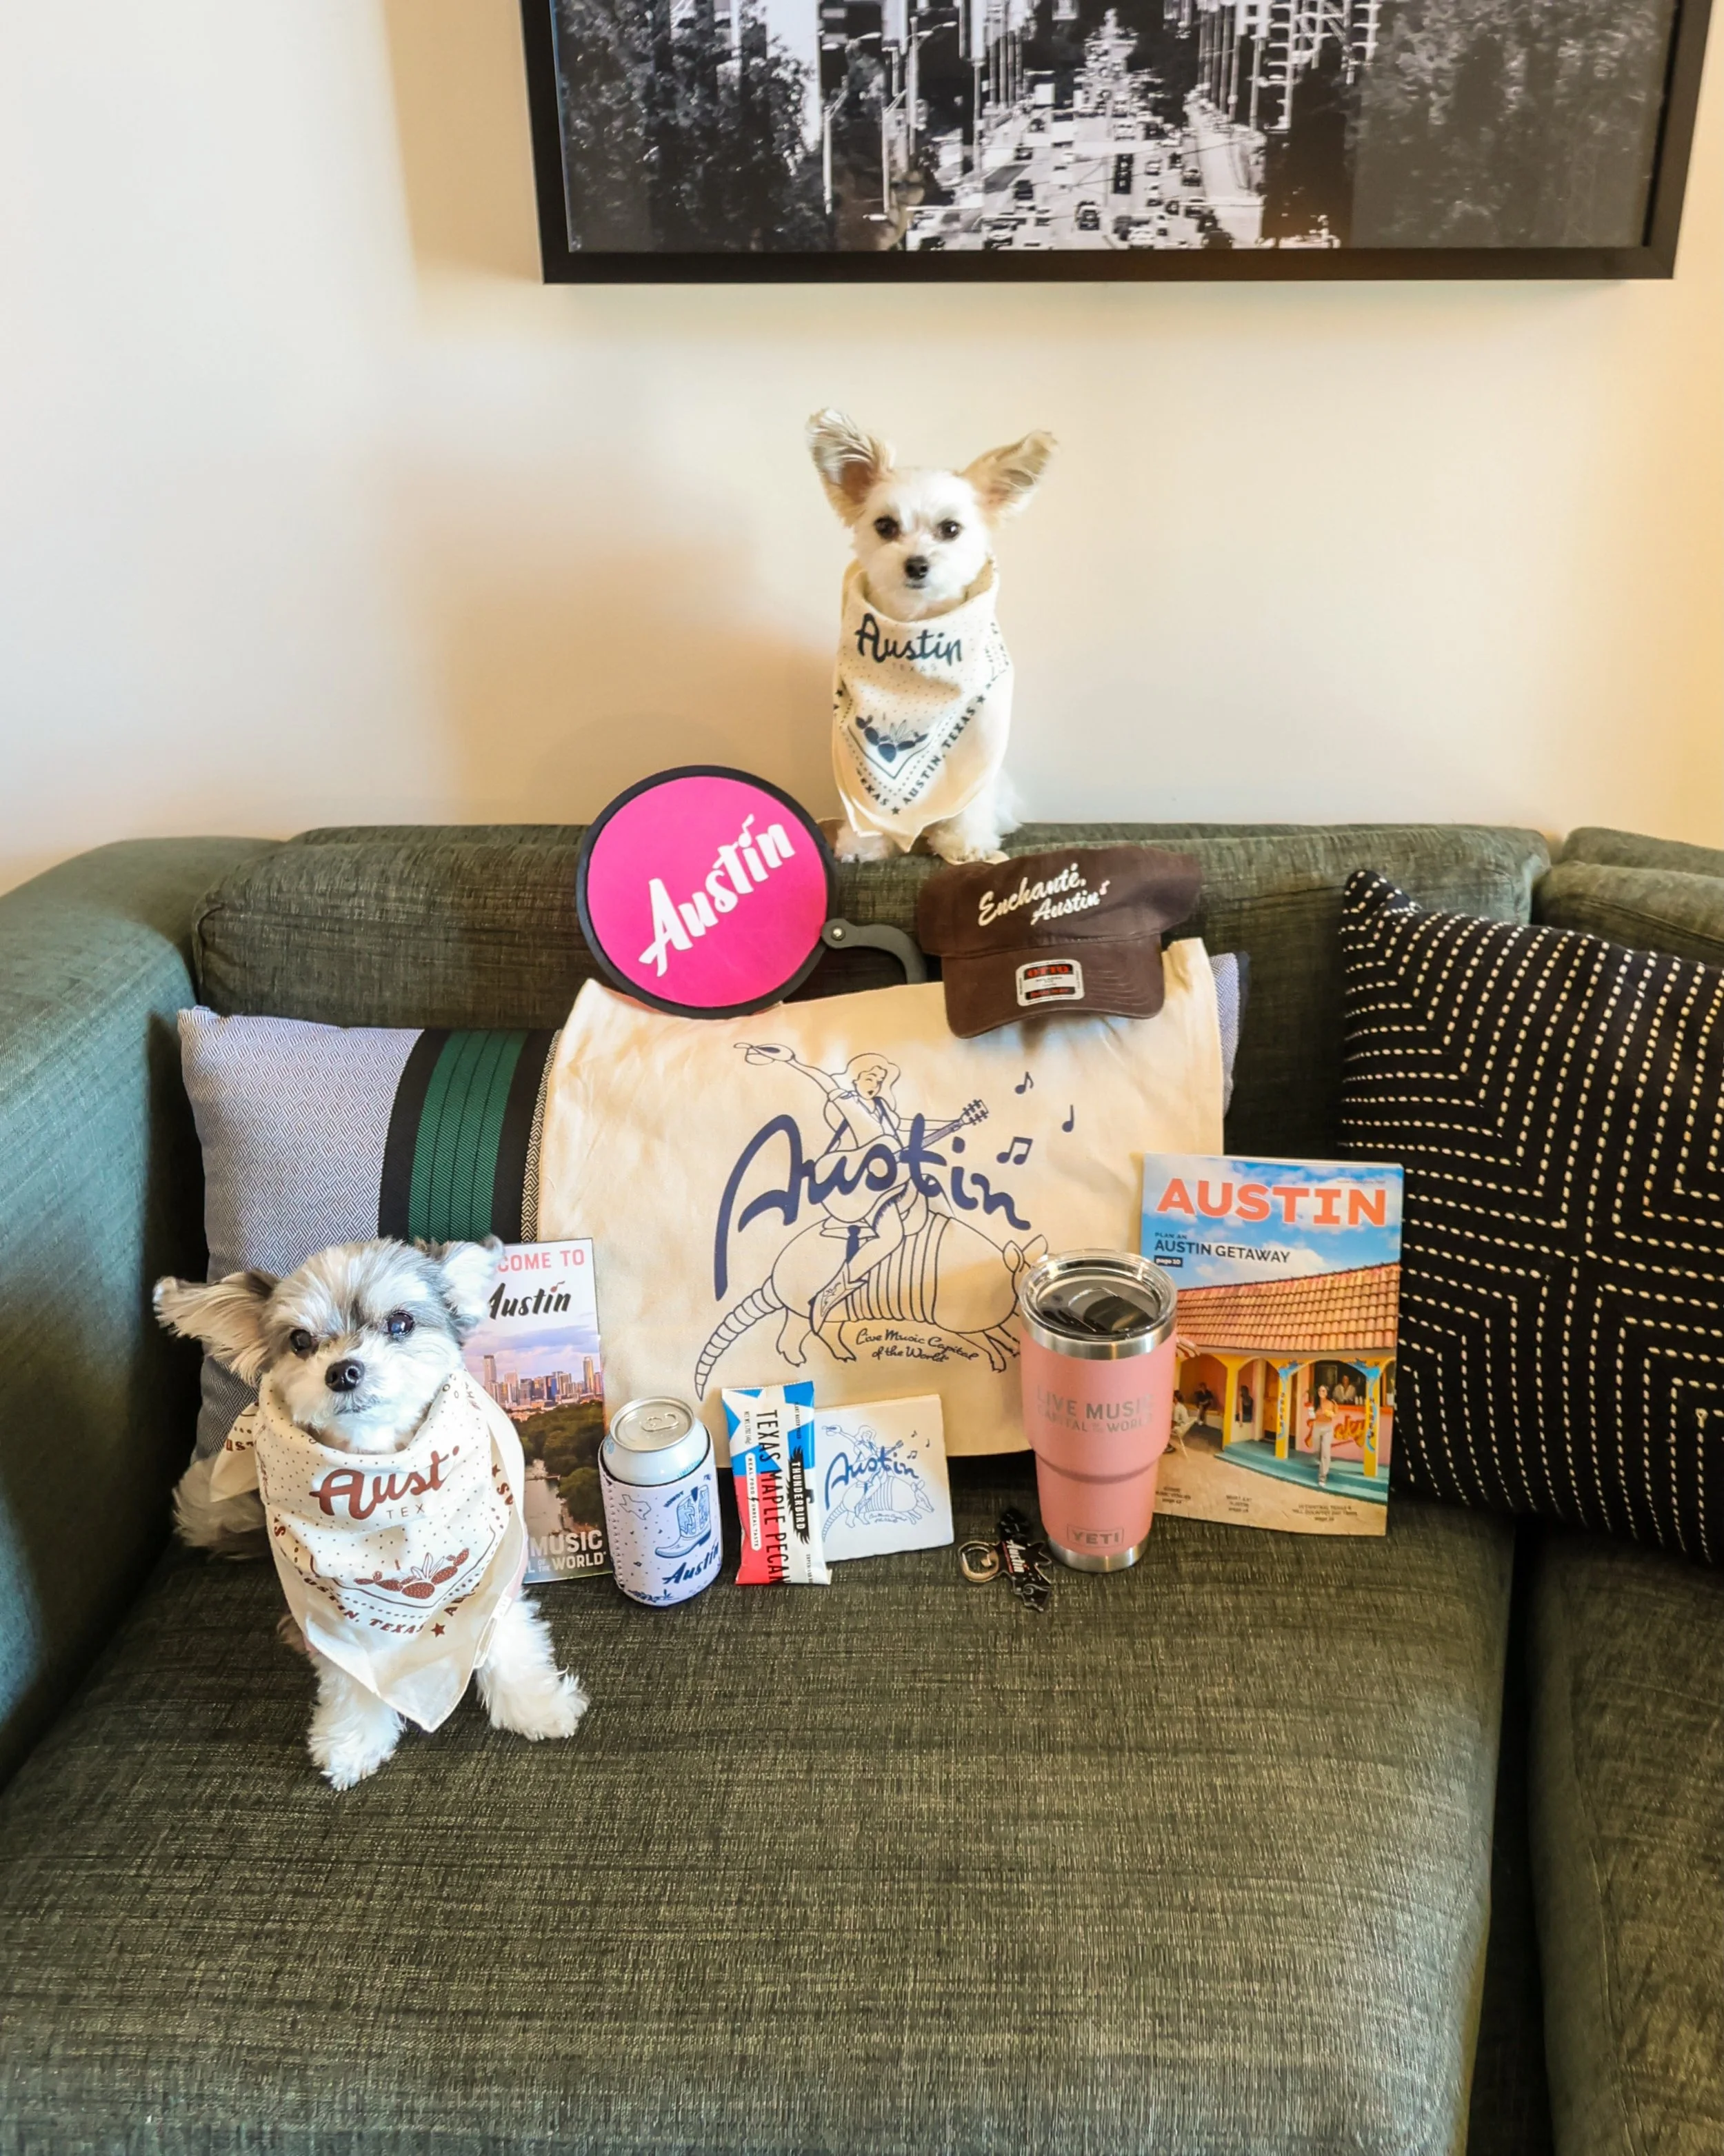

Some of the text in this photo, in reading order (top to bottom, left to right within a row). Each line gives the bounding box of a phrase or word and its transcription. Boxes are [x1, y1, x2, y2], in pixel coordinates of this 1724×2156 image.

[854, 612, 963, 666] Austin
[941, 707, 976, 748] TEXAS
[639, 814, 796, 977] Austin
[1030, 880, 1110, 925] Austin
[714, 1113, 1032, 1301] Austin
[1156, 1178, 1386, 1226] AUSTIN
[498, 1249, 585, 1272] COME TO
[1154, 1239, 1290, 1263] AUSTIN GETAWAY
[489, 1280, 572, 1320] Austin
[856, 1328, 979, 1361] Live Music Capital
[872, 1346, 883, 1361] of
[885, 1345, 904, 1358] the
[1037, 1384, 1078, 1416] LIVE
[309, 1445, 459, 1520] Aust
[756, 1409, 792, 1583] TEXAS MAPLE PECAN
[791, 1461, 806, 1530] THUNDERBIRD
[824, 1446, 919, 1511] Austin
[386, 1503, 425, 1520] TEX
[530, 1529, 603, 1557] MUSIC
[1005, 1539, 1026, 1573] Austin
[1073, 1531, 1119, 1544] YETI
[662, 1538, 719, 1584] Austin
